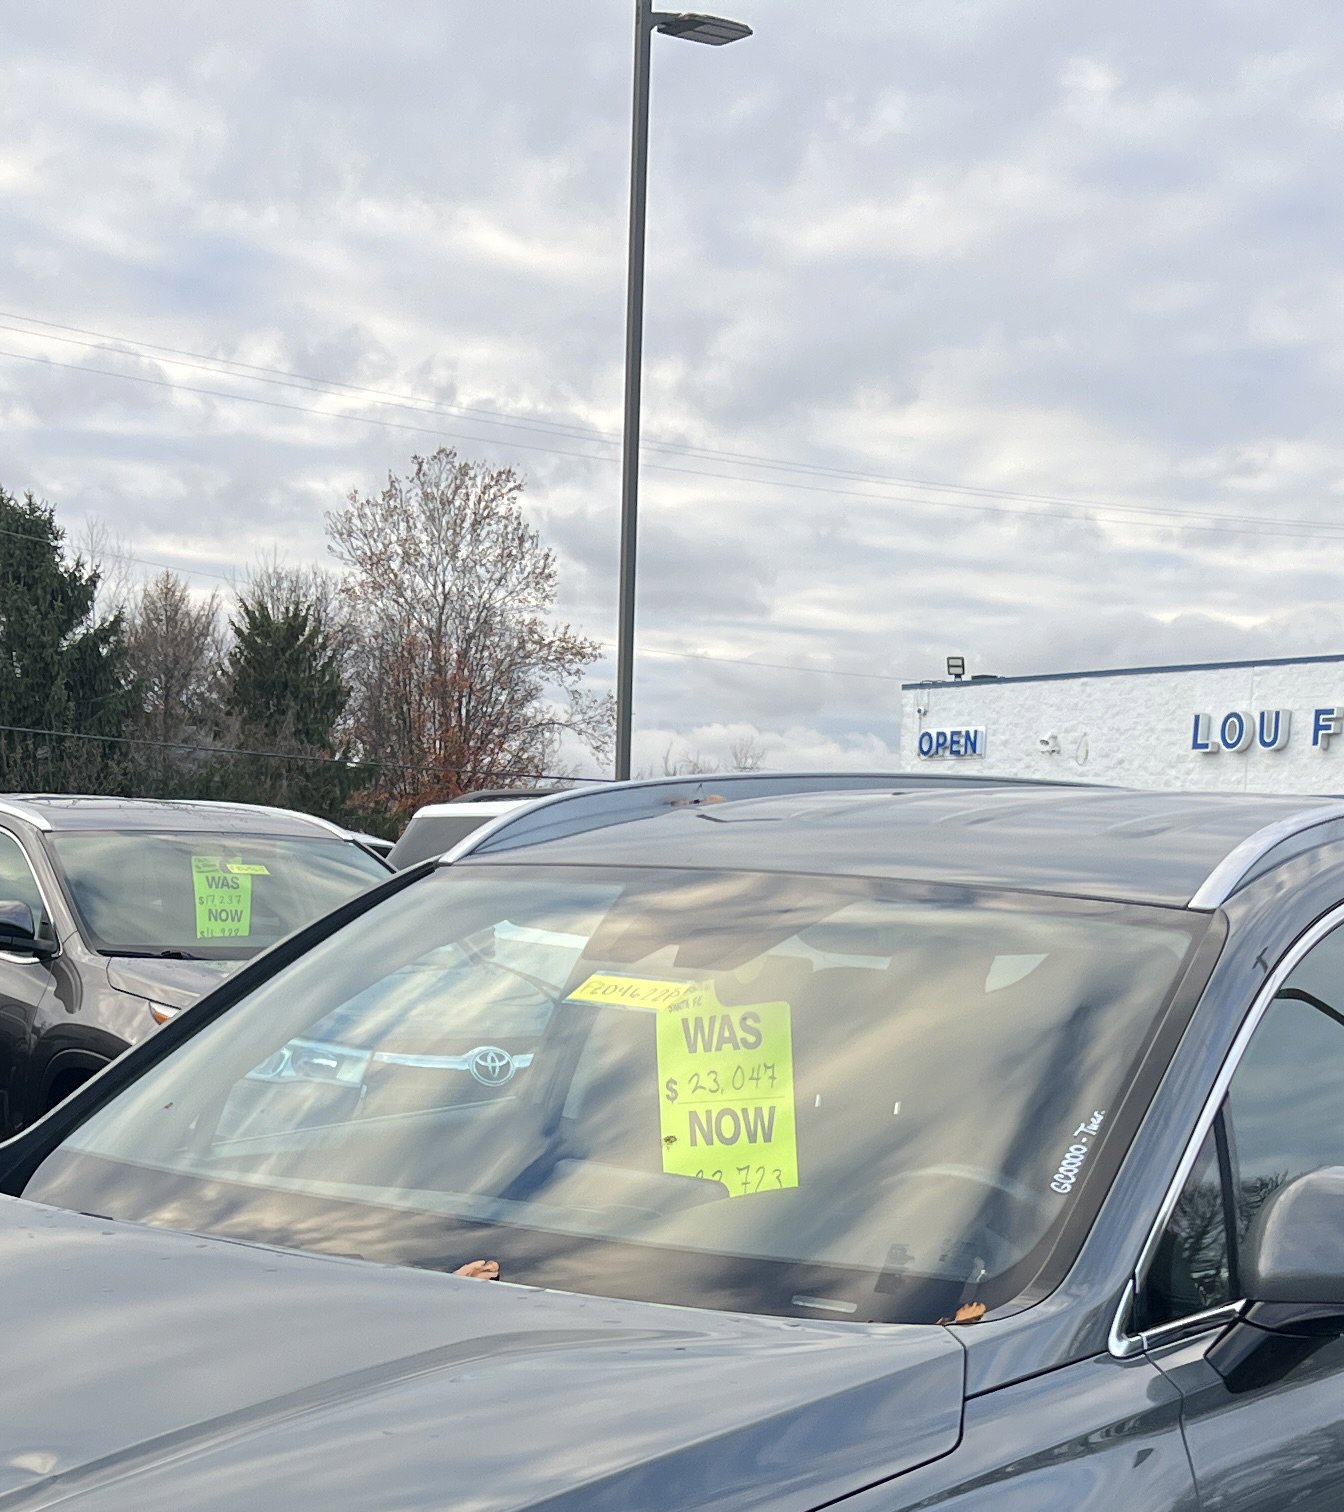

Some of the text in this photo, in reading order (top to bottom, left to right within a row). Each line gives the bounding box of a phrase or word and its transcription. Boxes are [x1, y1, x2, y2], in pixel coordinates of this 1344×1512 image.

[919, 729, 978, 757] OPEN
[1191, 709, 1284, 751] LOU
[206, 876, 240, 890] WAS
[208, 908, 244, 923] NOW
[681, 1011, 763, 1054] WAS
[689, 1106, 776, 1147] NOW
